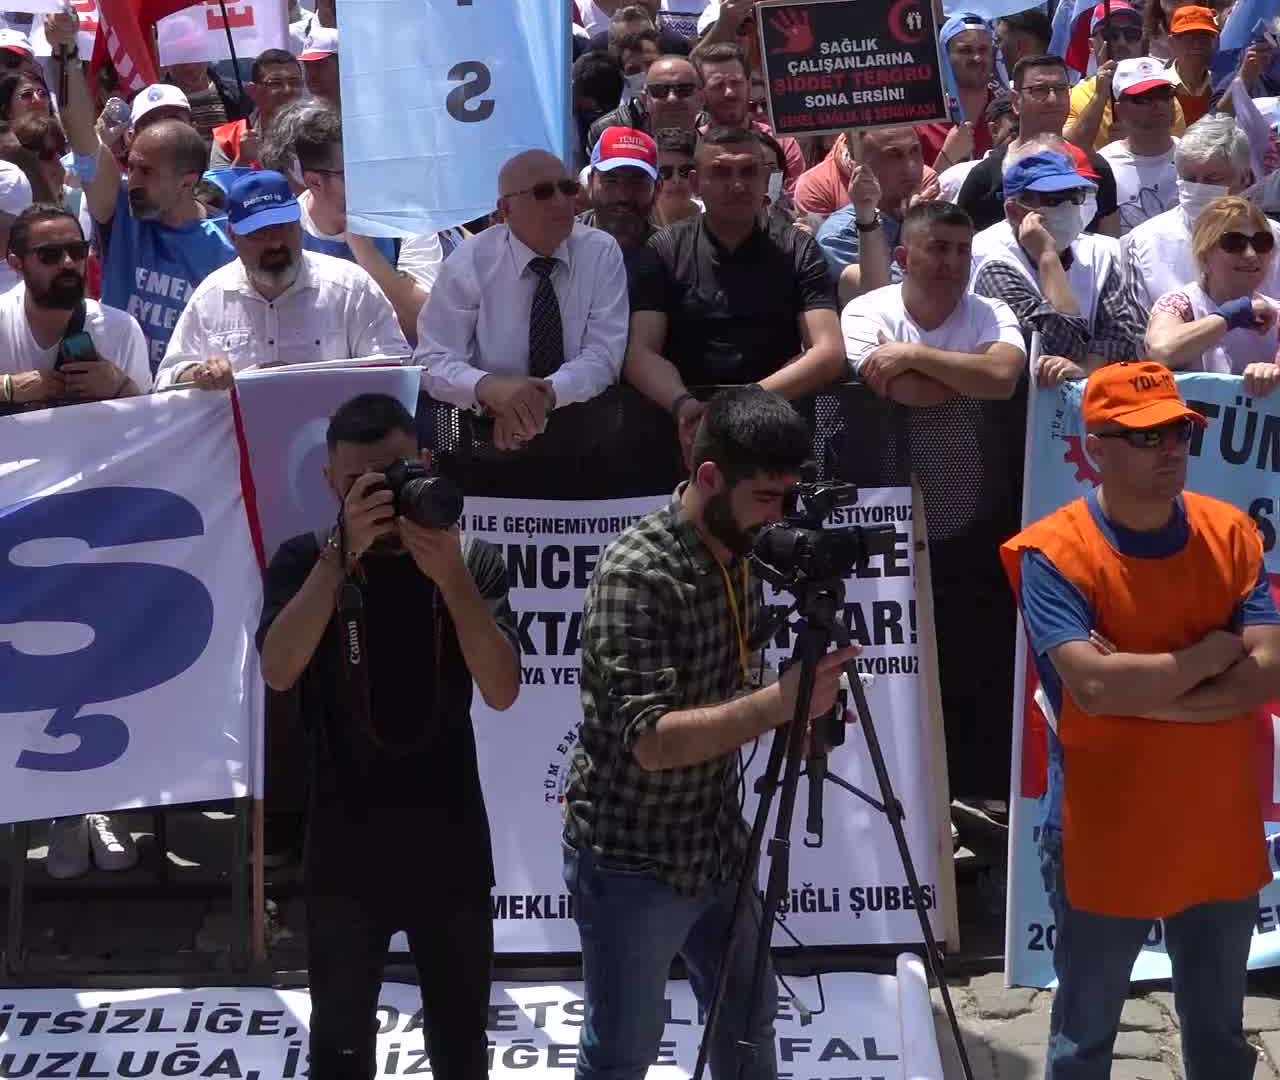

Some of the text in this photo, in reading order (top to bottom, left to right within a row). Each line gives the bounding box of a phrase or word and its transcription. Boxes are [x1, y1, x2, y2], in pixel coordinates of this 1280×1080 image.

[820, 37, 879, 55] SAĞLIK
[787, 52, 914, 77] ÇALIŞANLARINA
[804, 86, 905, 109] SONA ERSİN!
